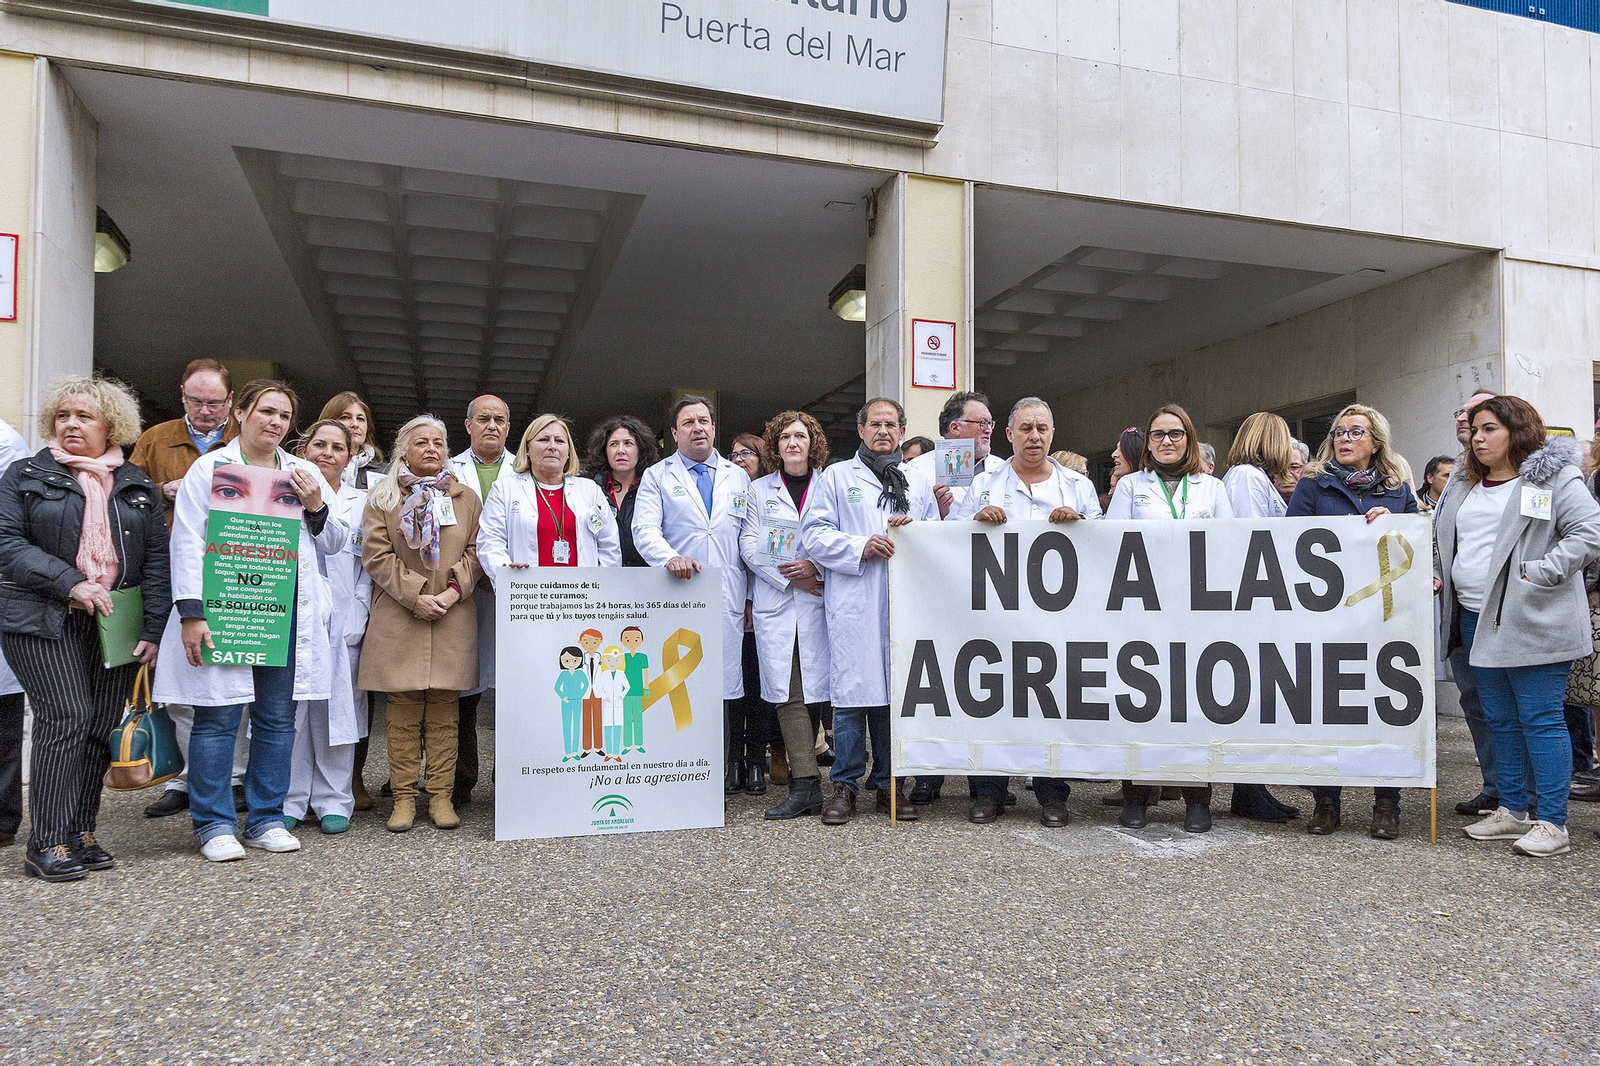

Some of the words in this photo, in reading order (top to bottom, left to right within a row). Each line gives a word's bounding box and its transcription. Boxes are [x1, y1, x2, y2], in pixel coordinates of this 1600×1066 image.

[661, 2, 770, 51] Puerta
[786, 26, 830, 60] del
[846, 34, 906, 72] Mar
[205, 542, 298, 562] AGRESIÓN
[970, 530, 1080, 612] NO
[1105, 531, 1161, 612] A
[1188, 528, 1345, 612] LAS
[237, 573, 262, 586] NO
[510, 582, 538, 590] Porque
[206, 600, 222, 608] ES
[226, 600, 286, 613] SOLUCIÓN
[540, 602, 582, 610] trabajamos
[510, 613, 528, 621] para
[598, 612, 625, 620] tengáis
[211, 651, 267, 664] SATSE
[900, 638, 1424, 726] AGRESIONES
[522, 767, 530, 775] El
[532, 766, 564, 775] respeto
[578, 762, 628, 772] fundamental
[590, 775, 611, 789] ¡No
[615, 776, 622, 785] a
[625, 773, 641, 784] las
[644, 770, 710, 786] agresiones!
